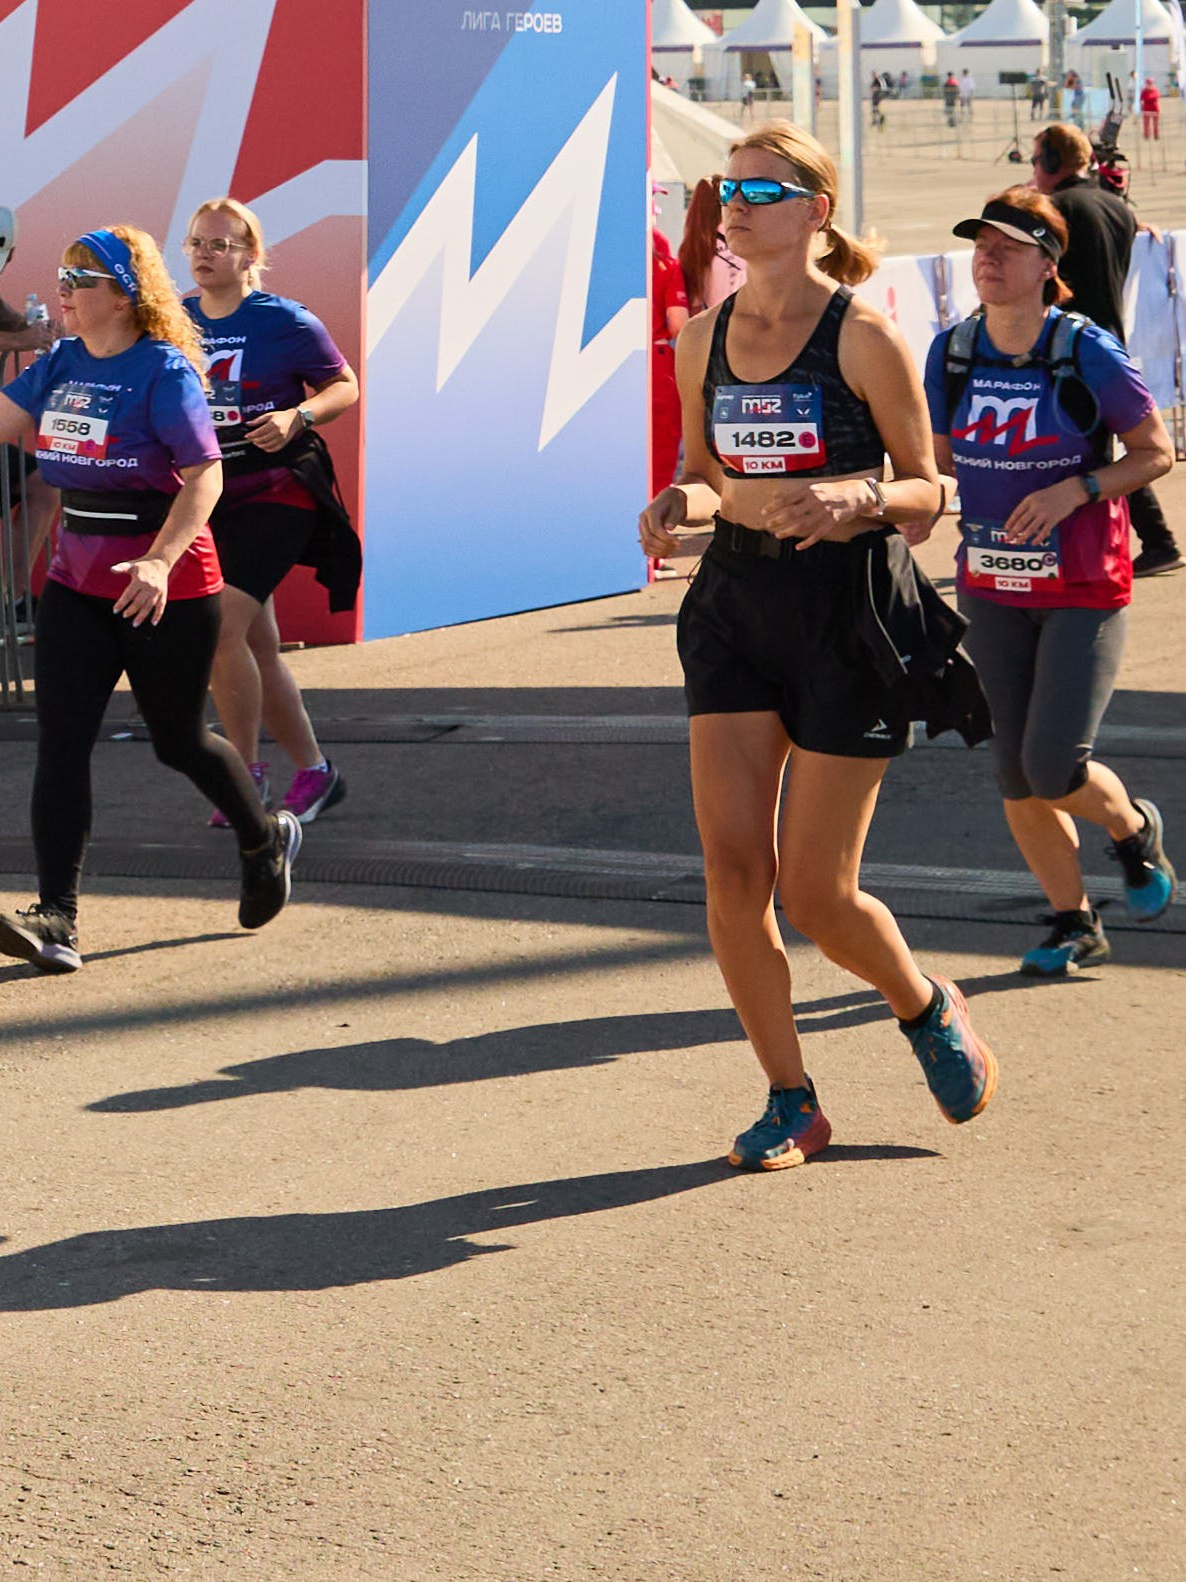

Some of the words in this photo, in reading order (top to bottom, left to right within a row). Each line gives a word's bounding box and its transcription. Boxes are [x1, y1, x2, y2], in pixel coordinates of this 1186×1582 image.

[461, 11, 501, 31] ЛИГА
[506, 12, 563, 33] ГЕРОЕВ
[972, 379, 1042, 391] МАРАФОН
[52, 418, 91, 436] 1558
[732, 431, 796, 448] 1482
[61, 453, 139, 468] НОВГОРОД
[744, 460, 758, 470] 10
[994, 454, 1082, 471] НОВГОРОД
